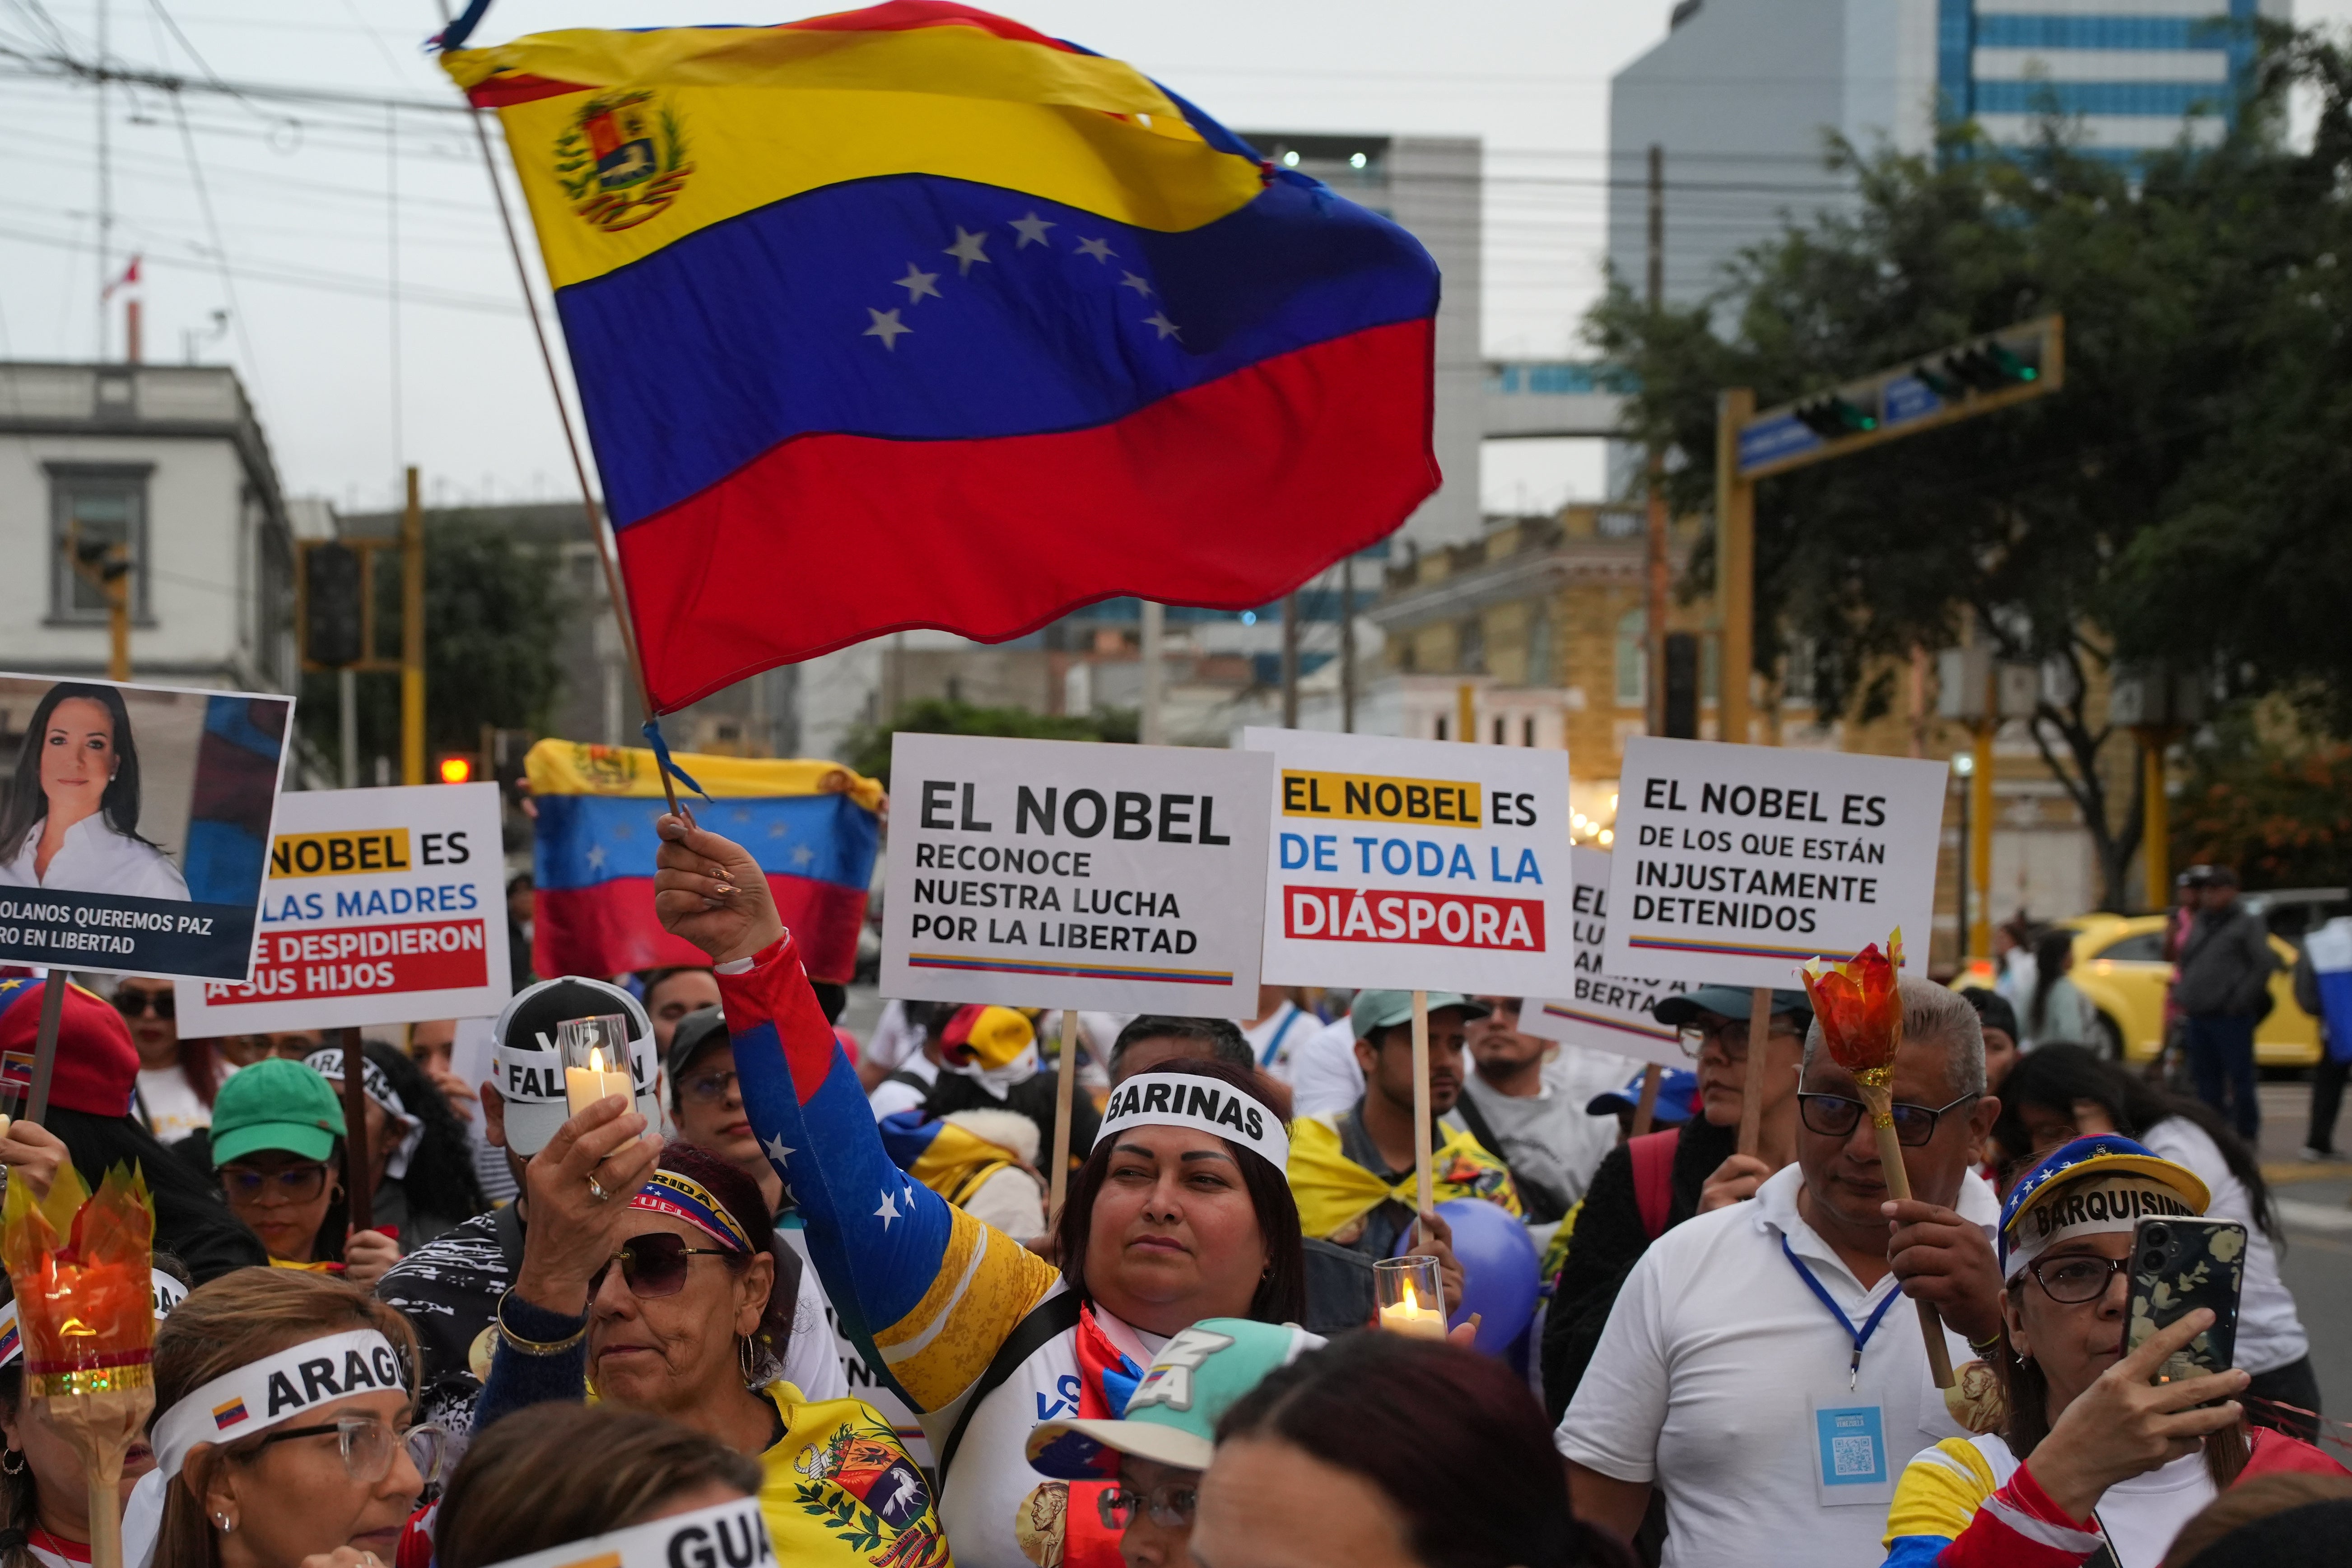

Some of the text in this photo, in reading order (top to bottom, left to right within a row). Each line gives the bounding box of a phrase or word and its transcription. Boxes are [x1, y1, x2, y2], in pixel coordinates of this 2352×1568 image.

[920, 780, 1231, 845] EL NOBEL
[1284, 777, 1537, 827] EL NOBEL ES
[1644, 777, 1886, 827] EL NOBEL ES
[269, 832, 470, 875] NOBEL ES
[916, 843, 1091, 877] RECONOCE
[1280, 833, 1543, 884] DE TODA LA
[1639, 825, 1885, 864] DE LOS QUE ESTÁN
[914, 879, 1180, 919] NUESTRA LUCHA
[1572, 884, 1607, 918] EL
[1636, 860, 1877, 903] INJUSTAMENTE
[0, 901, 213, 936] OLANOS QUEREMOS PAZ
[262, 884, 478, 922] LAS MADRES
[1293, 888, 1534, 948] DIÁSPORA
[1632, 894, 1816, 933] DETENIDOS
[0, 926, 135, 954] RO EN LIBERTAD
[278, 924, 484, 963] DESPIDIERON
[912, 915, 1197, 954] POR LA LIBERTAD
[238, 968, 297, 998] SUS
[306, 961, 396, 991] HIJOS
[1574, 977, 1656, 1014] BERTA
[509, 1055, 645, 1097] FALN
[1106, 1084, 1264, 1141] BARINAS
[650, 1174, 711, 1207] RIDA
[2034, 1190, 2195, 1238] BARQUISIM
[268, 1345, 405, 1417] ARAG
[890, 1543, 901, 1555] ABRIL
